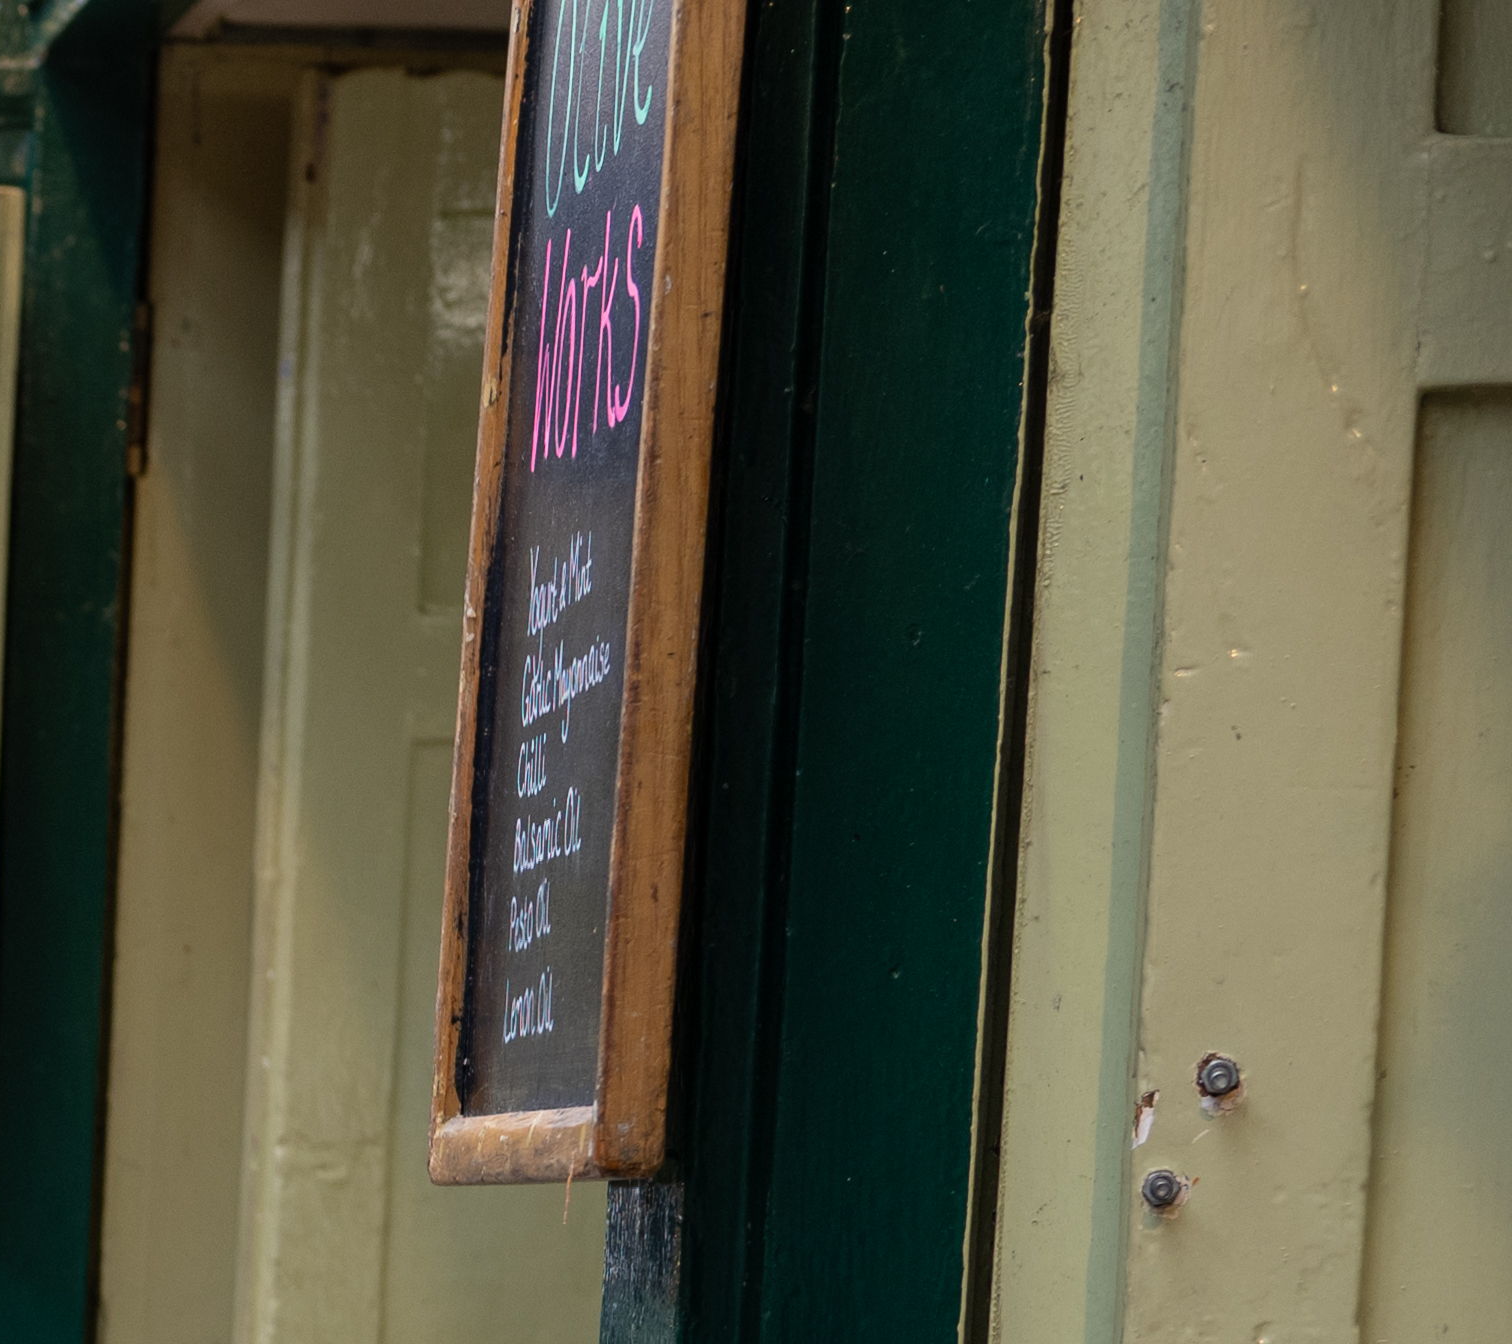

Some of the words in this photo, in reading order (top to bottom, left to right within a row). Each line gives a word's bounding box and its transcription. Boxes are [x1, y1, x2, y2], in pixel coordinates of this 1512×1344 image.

[530, 204, 644, 473] Works
[527, 546, 558, 682] Yogurt
[569, 530, 592, 604] Mint
[521, 653, 552, 727] Garlic
[553, 635, 611, 744] Mayonnaise
[517, 733, 547, 798] Chilli
[514, 798, 562, 873] Balsamic
[564, 786, 582, 856] Oil
[509, 896, 534, 953] Pesto
[535, 877, 551, 938] Oil
[503, 978, 536, 1044] Lemon
[537, 965, 554, 1035] Oil
